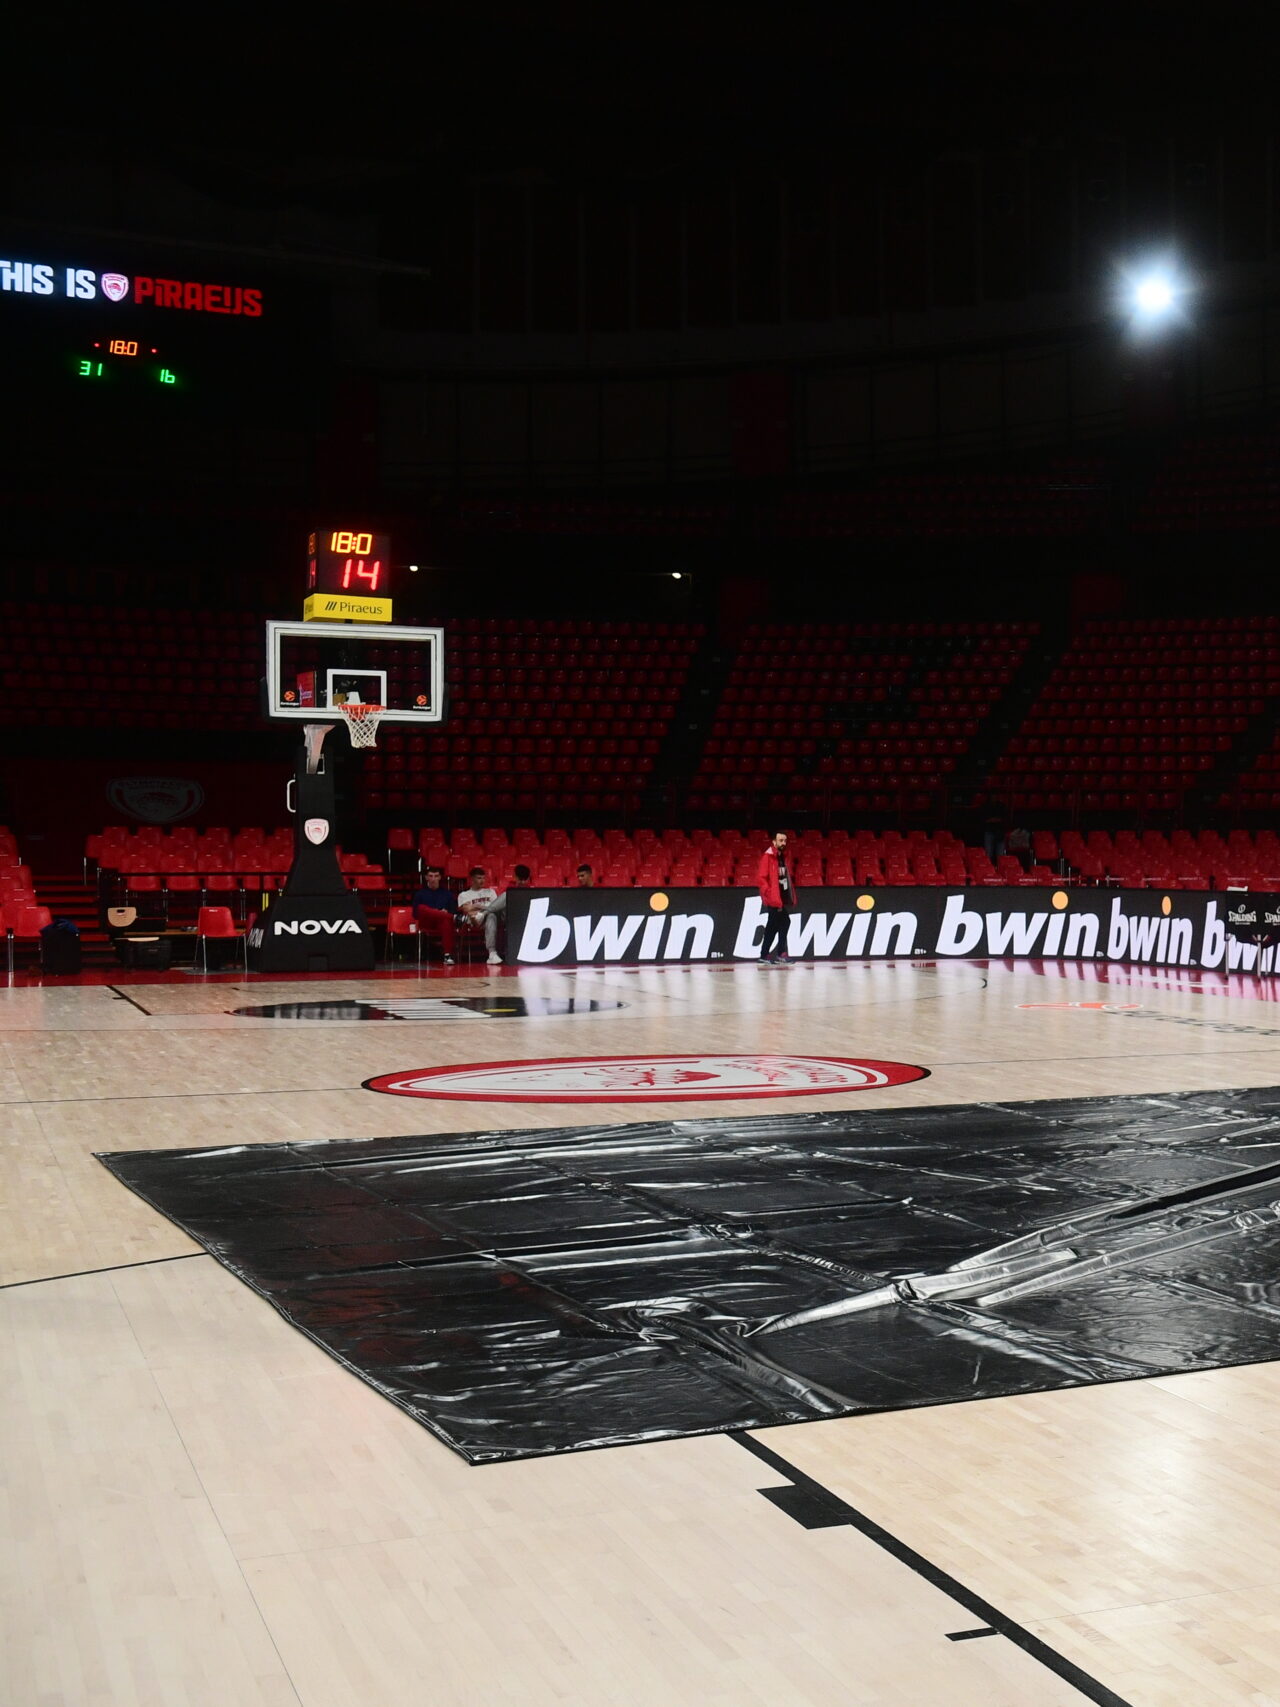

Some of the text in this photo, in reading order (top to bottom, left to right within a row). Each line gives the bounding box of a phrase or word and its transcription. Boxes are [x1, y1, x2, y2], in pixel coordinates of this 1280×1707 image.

[0, 260, 54, 295] THIS
[66, 267, 96, 300] IS
[342, 559, 381, 591] 14
[340, 601, 383, 615] Piraeus
[274, 920, 362, 936] NOVA
[517, 892, 714, 963] bwin
[935, 891, 1099, 957] bwin
[1107, 896, 1193, 967] bwin
[1228, 911, 1256, 922] SPALDING
